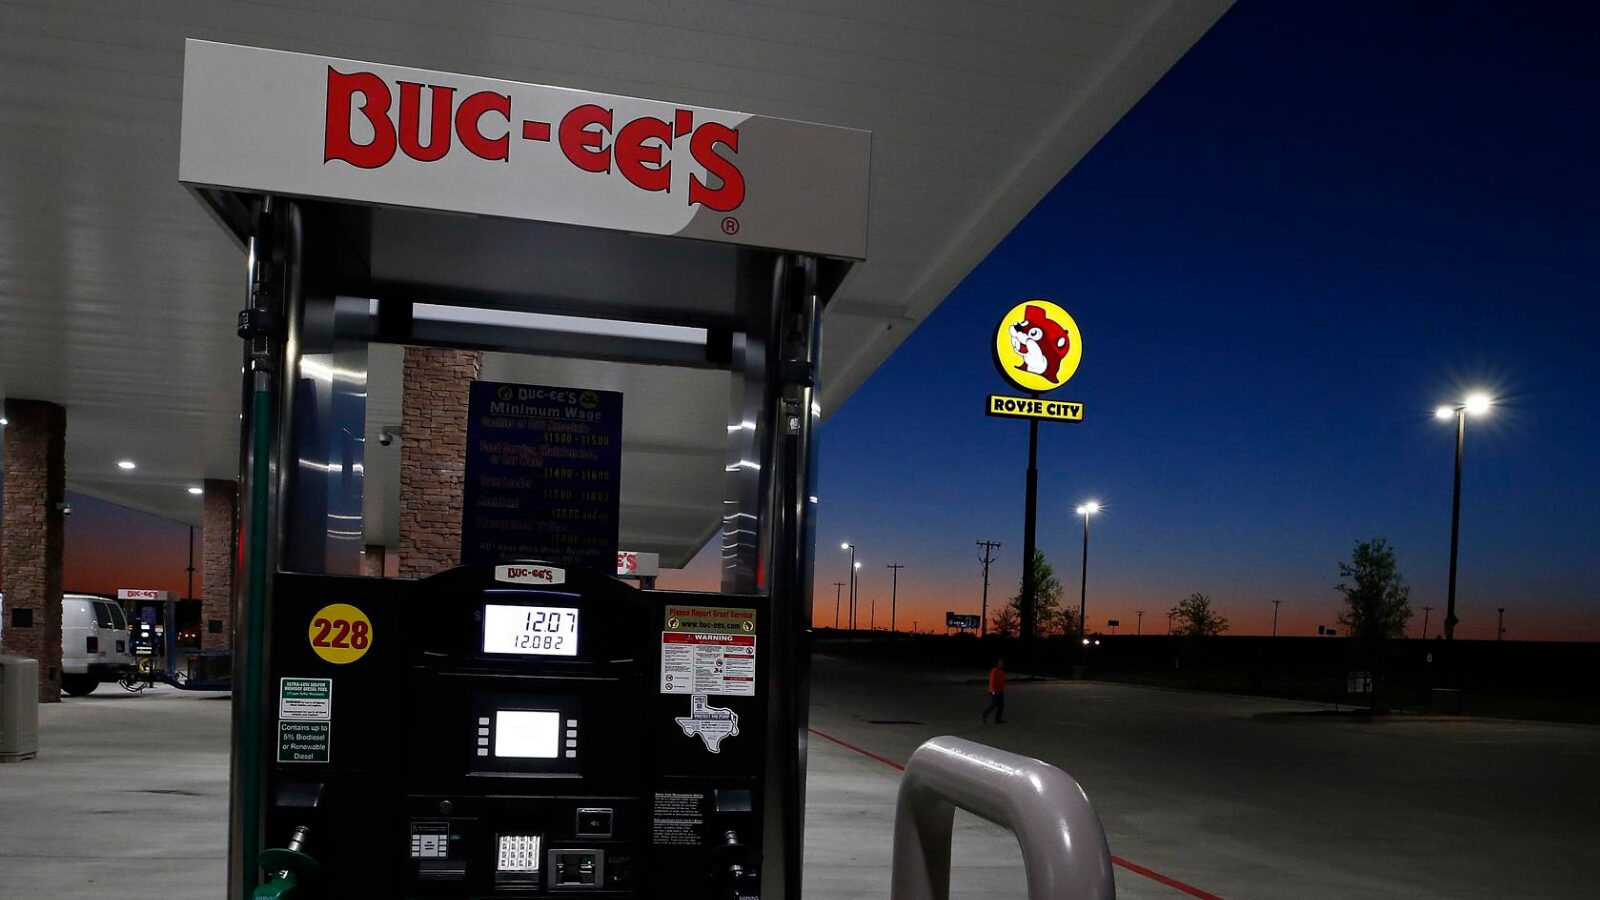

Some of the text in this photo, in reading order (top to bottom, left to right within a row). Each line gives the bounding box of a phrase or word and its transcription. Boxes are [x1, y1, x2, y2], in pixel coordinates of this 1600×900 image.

[490, 401, 602, 420] Minimum Wage
[994, 398, 1080, 417] ROYSE CITY
[691, 609, 711, 618] Report
[526, 611, 576, 633] 12.07
[312, 618, 369, 650] 228
[515, 635, 563, 650] 12.082
[281, 723, 310, 731] Contains
[296, 733, 325, 741] Biodiesel
[290, 742, 326, 750] Renewable
[293, 752, 314, 760] Diesel
